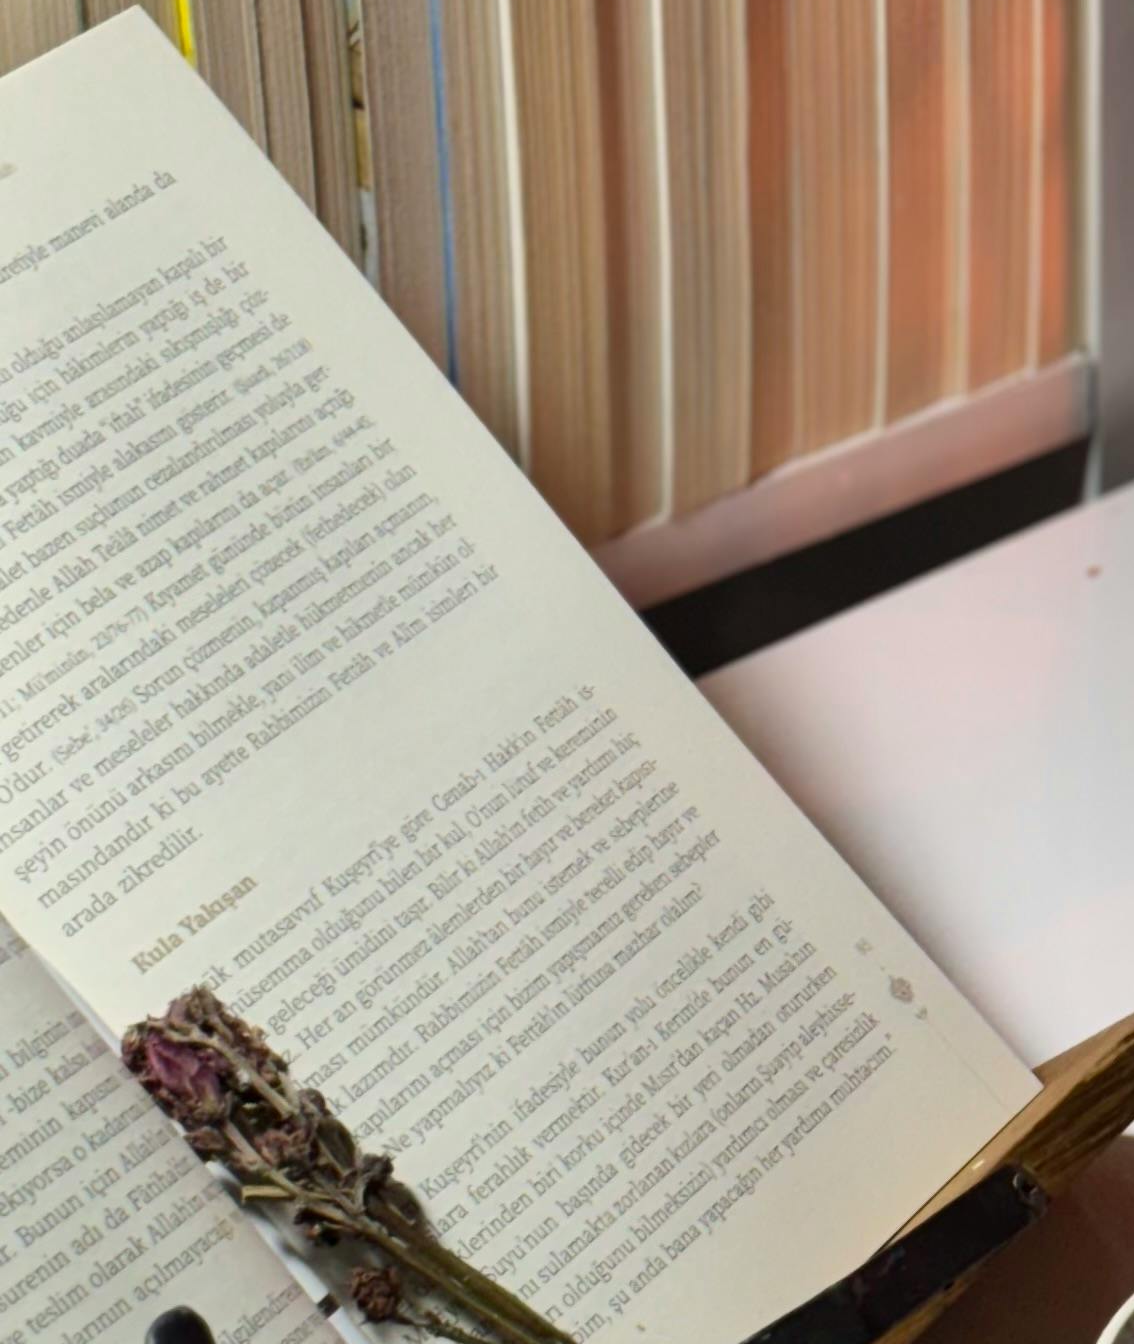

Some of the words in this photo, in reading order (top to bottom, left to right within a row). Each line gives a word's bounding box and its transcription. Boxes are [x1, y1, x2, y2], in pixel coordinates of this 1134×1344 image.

[0, 497, 60, 541] Fettâh
[55, 428, 107, 465] duada
[21, 529, 78, 569] bazen
[41, 609, 82, 640] için
[74, 585, 118, 616] bela
[112, 571, 137, 590] ve
[134, 547, 173, 578] azap
[236, 489, 262, 510] da
[51, 554, 99, 594] Allah
[134, 498, 184, 537] nimet
[177, 488, 201, 507] ve
[142, 562, 211, 613] Kıyamet
[207, 521, 272, 576] gününde
[0, 692, 81, 760] getirerek
[79, 622, 178, 701] aralarındaki
[36, 814, 154, 909] masındandır
[148, 795, 177, 821] ki
[170, 781, 203, 806] bu
[199, 745, 250, 786] ayette
[244, 686, 333, 751] Rabbimizin
[371, 640, 395, 659] ve
[470, 562, 499, 587] bir
[67, 772, 95, 793] ve
[91, 711, 174, 778] meseleler
[168, 662, 246, 720] hakkında
[242, 623, 301, 670] adaletle
[425, 513, 457, 539] her
[130, 664, 185, 705] Sorun
[181, 614, 263, 673] çözmenin,
[13, 836, 68, 884] şeyin
[63, 787, 129, 841] önünü
[125, 741, 196, 796] arkasını
[186, 694, 266, 749] bilmekle,
[320, 634, 343, 653] ve
[60, 889, 119, 938] arada
[116, 826, 204, 894] zikredilir.
[129, 932, 185, 975] Kula
[176, 875, 258, 937] Yakışan
[231, 886, 325, 970] mutasavvıf
[399, 808, 434, 844] göre
[430, 767, 487, 812] Cenab-ı
[266, 971, 337, 1036] geleceği
[331, 923, 398, 977] ümidini
[392, 895, 434, 929] taşır.
[424, 868, 463, 901] Bilir
[455, 858, 479, 878] ki
[550, 784, 572, 803] ve
[293, 1015, 334, 1051] Her
[332, 999, 358, 1024] an
[354, 938, 433, 1010] görünmez
[497, 861, 526, 887] bir
[553, 823, 575, 842] ve
[310, 888, 387, 952] olduğunu
[377, 859, 424, 896] bilen
[414, 841, 444, 868] bir
[434, 819, 473, 850] kul,
[534, 755, 557, 773] ve
[340, 1039, 420, 1104] lazımdır.
[412, 969, 502, 1044] Rabbimizin
[622, 843, 655, 873] edip
[679, 805, 699, 823] ve
[344, 970, 449, 1056] mümkündür.
[501, 893, 546, 927] bunu
[589, 837, 611, 854] ve
[428, 1028, 485, 1079] açması
[477, 1004, 514, 1035] için
[504, 972, 552, 1012] bizim
[667, 828, 721, 878] sebepler
[511, 1060, 581, 1123] ifadesiyle
[574, 1020, 627, 1065] bunun
[622, 994, 658, 1031] yolu
[653, 945, 713, 1000] öncelikle
[705, 912, 750, 952] kendi
[746, 892, 776, 924] gibi
[70, 1144, 88, 1162] o
[380, 1132, 413, 1164] Ne
[408, 1062, 498, 1144] yapmalıyız
[487, 1045, 513, 1069] ki
[465, 1145, 533, 1205] ferahlık
[531, 1085, 601, 1149] vermektir.
[706, 952, 756, 995] bunun
[752, 936, 774, 956] en
[526, 1165, 563, 1198] biri
[555, 1128, 606, 1172] korku
[598, 1091, 647, 1135] içinde
[697, 1008, 741, 1046] kaçan
[553, 1162, 619, 1218] başında
[617, 1113, 672, 1170] gidecek
[666, 1093, 694, 1119] bir
[691, 1068, 722, 1102] yeri
[720, 1020, 777, 1073] olmadan
[560, 1238, 637, 1308] olduğunu
[627, 1162, 717, 1244] bilmeksizin)
[710, 1114, 770, 1176] yardımcı
[803, 1064, 824, 1083] ve
[820, 1010, 881, 1073] çaresizlik
[13, 1193, 85, 1248] Bunun
[79, 1166, 122, 1200] için
[24, 1283, 91, 1335] teslim
[87, 1235, 149, 1289] olarak
[70, 1224, 104, 1256] adı
[103, 1205, 131, 1230] da
[536, 1210, 618, 1284] sulamakta
[611, 1156, 676, 1217] zorlanan
[665, 1118, 718, 1164] kızlara
[607, 1288, 631, 1315] şu
[627, 1255, 669, 1294] anda
[658, 1223, 702, 1262] bana
[696, 1166, 763, 1234] yapacağın
[754, 1143, 785, 1172] her
[779, 1099, 833, 1158] yardıma
